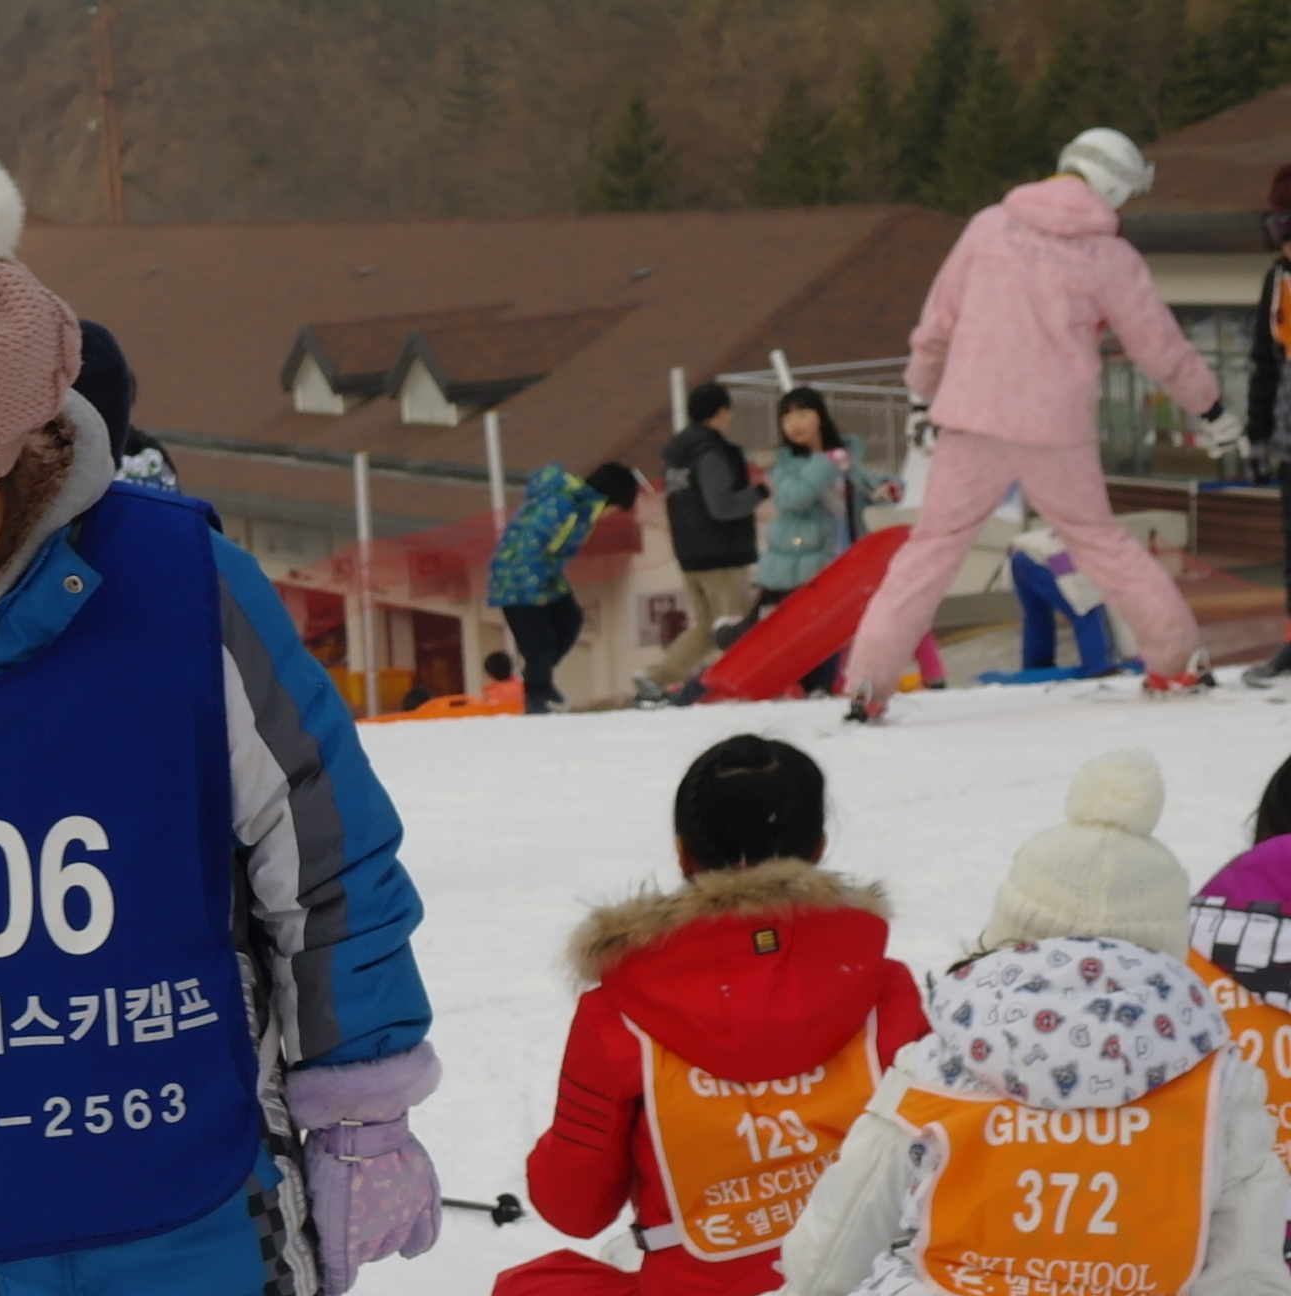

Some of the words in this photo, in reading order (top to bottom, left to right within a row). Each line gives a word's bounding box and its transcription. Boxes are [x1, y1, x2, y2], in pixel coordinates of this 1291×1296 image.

[984, 1104, 1151, 1147] GROUP
[704, 1176, 752, 1207] SKI
[1012, 1168, 1119, 1235] 372
[1025, 1257, 1157, 1293] SCHOOL
